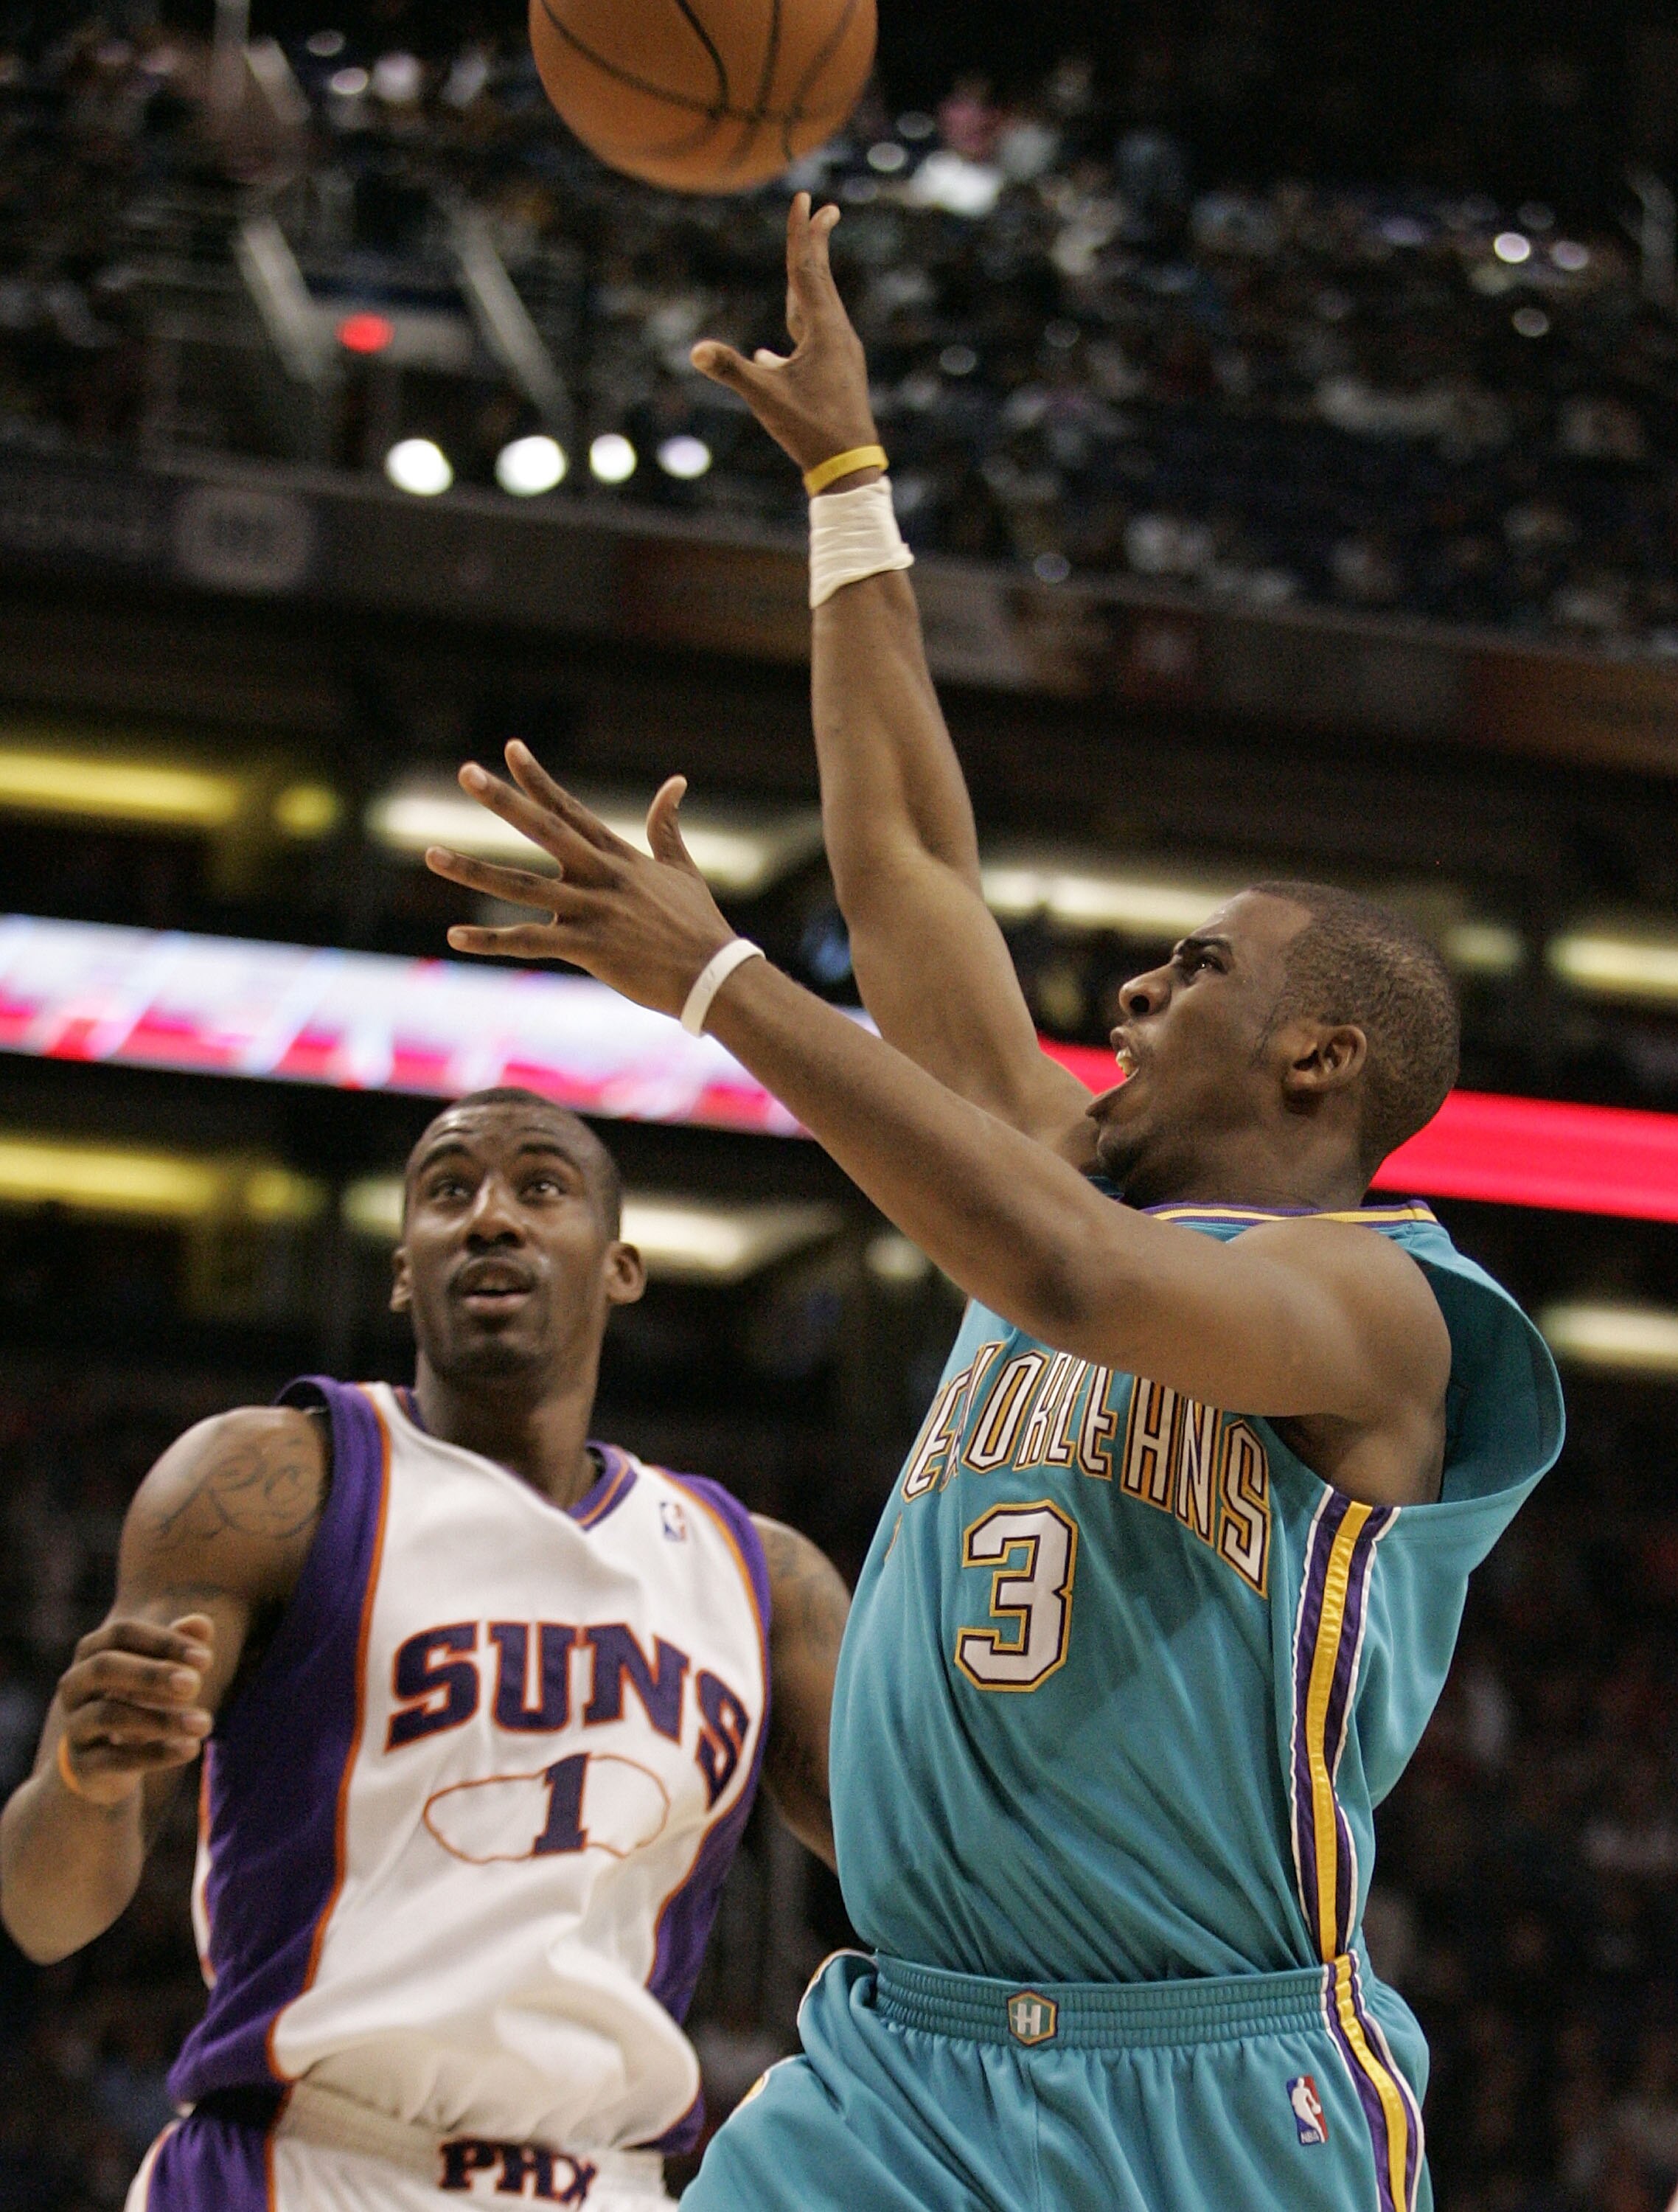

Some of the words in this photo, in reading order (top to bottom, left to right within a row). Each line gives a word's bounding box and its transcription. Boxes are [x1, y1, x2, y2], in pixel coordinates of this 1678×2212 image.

[954, 1499, 1079, 1692] 3
[383, 1621, 750, 1813] SUNS
[532, 1751, 591, 1857] 1
